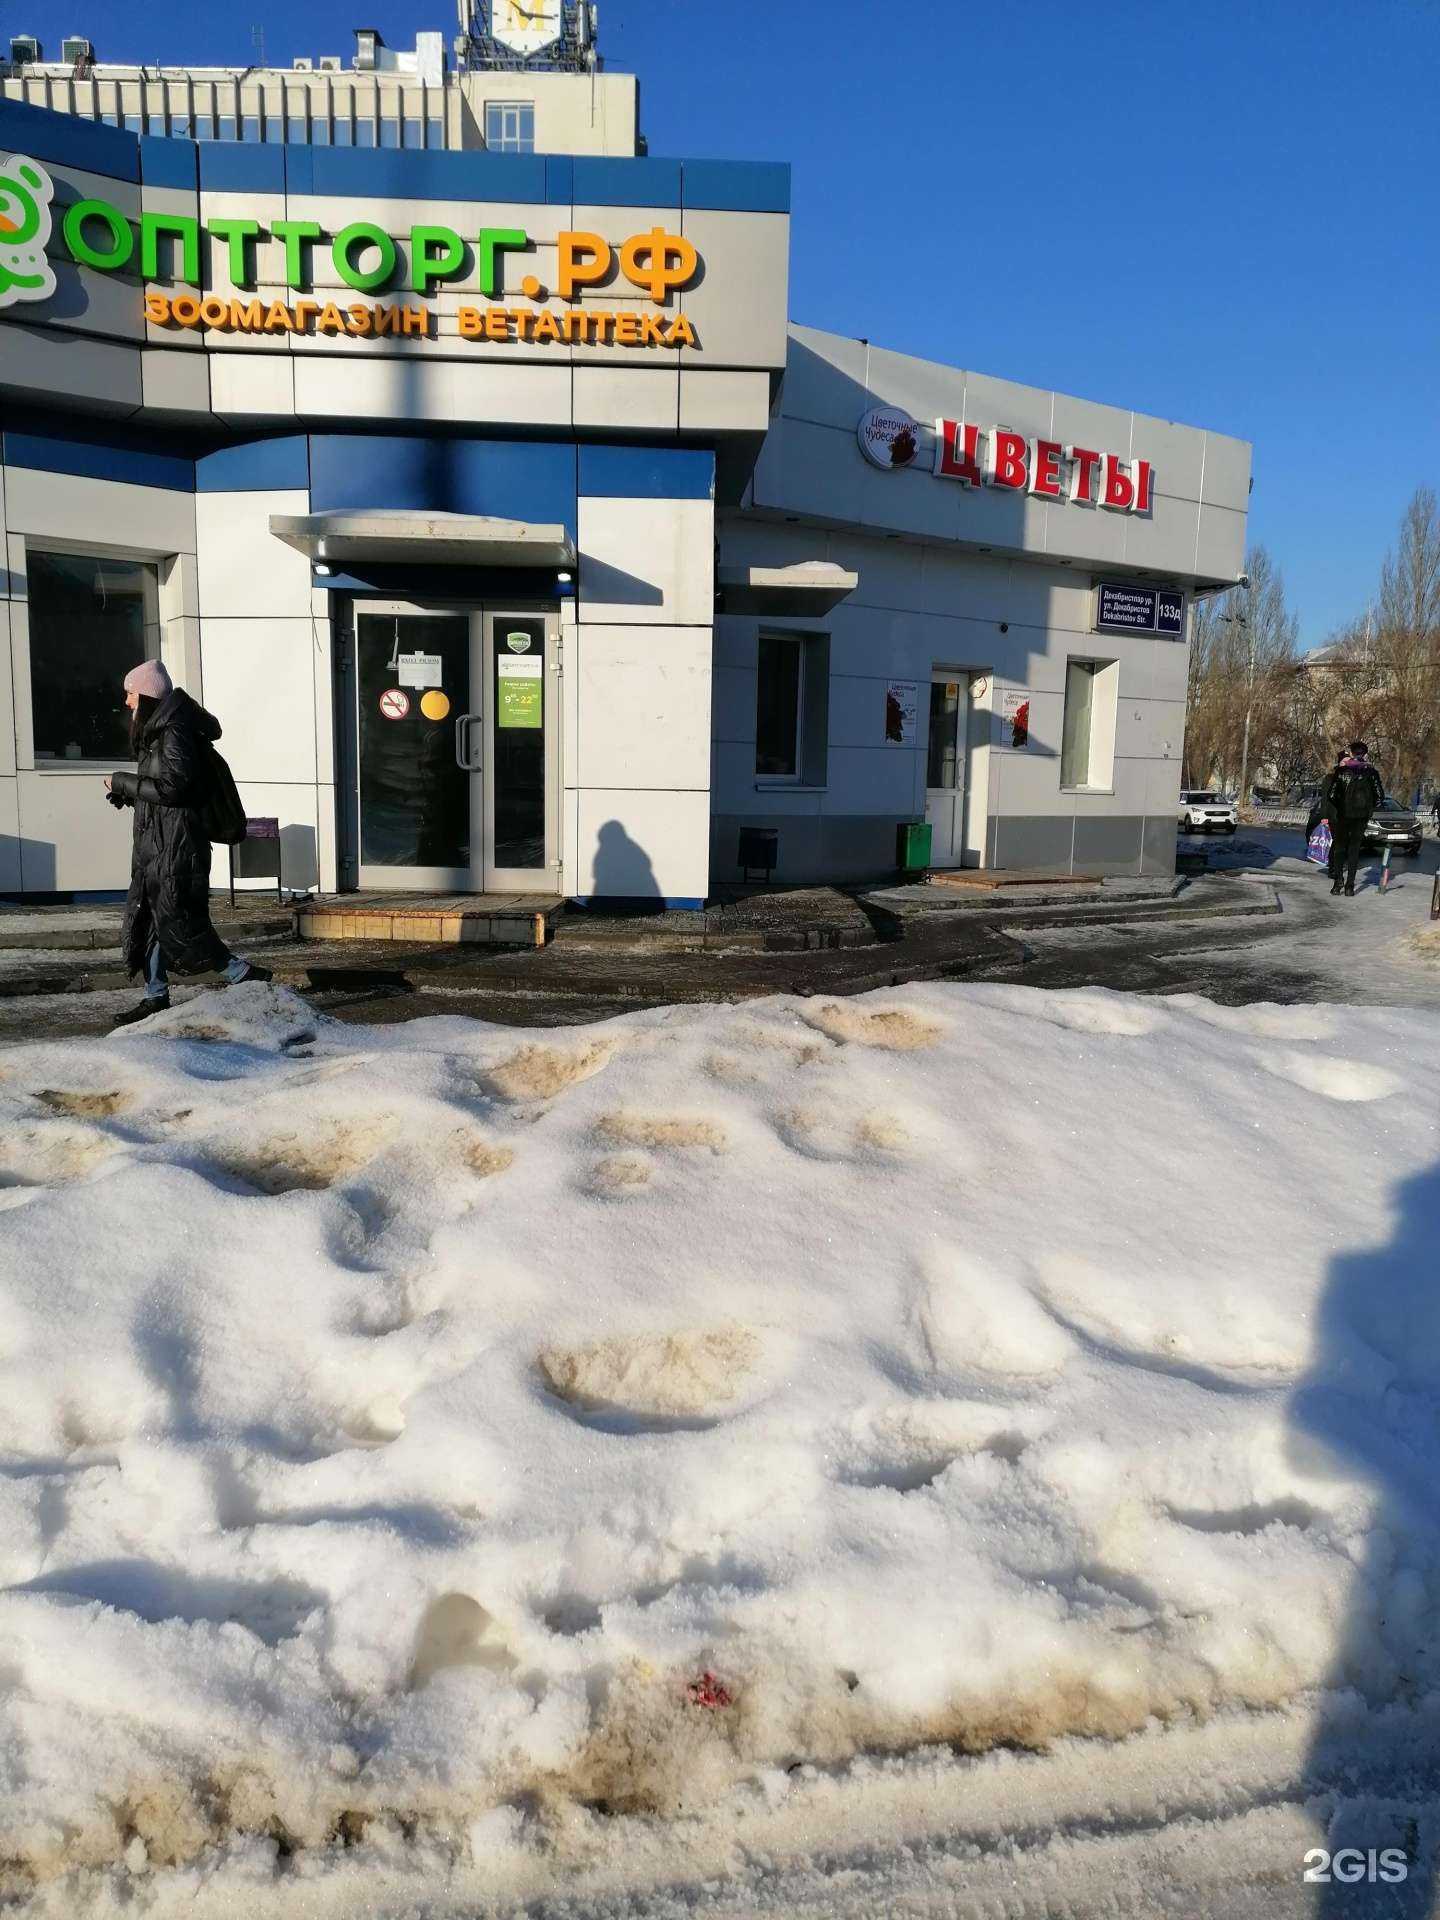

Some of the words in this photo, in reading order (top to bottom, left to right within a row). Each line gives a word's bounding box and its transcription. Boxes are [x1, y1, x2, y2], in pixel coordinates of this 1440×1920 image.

[63, 199, 700, 303] ОПТТОРГ.РФ
[144, 292, 430, 337] ЗООМАГАЗИН
[459, 308, 696, 348] ВЕТАПТЕКА
[865, 425, 895, 442] Чудеса
[871, 414, 919, 434] Цветочные
[936, 418, 1151, 512] ЦВЕТЫ
[1113, 602, 1150, 614] Декабристов
